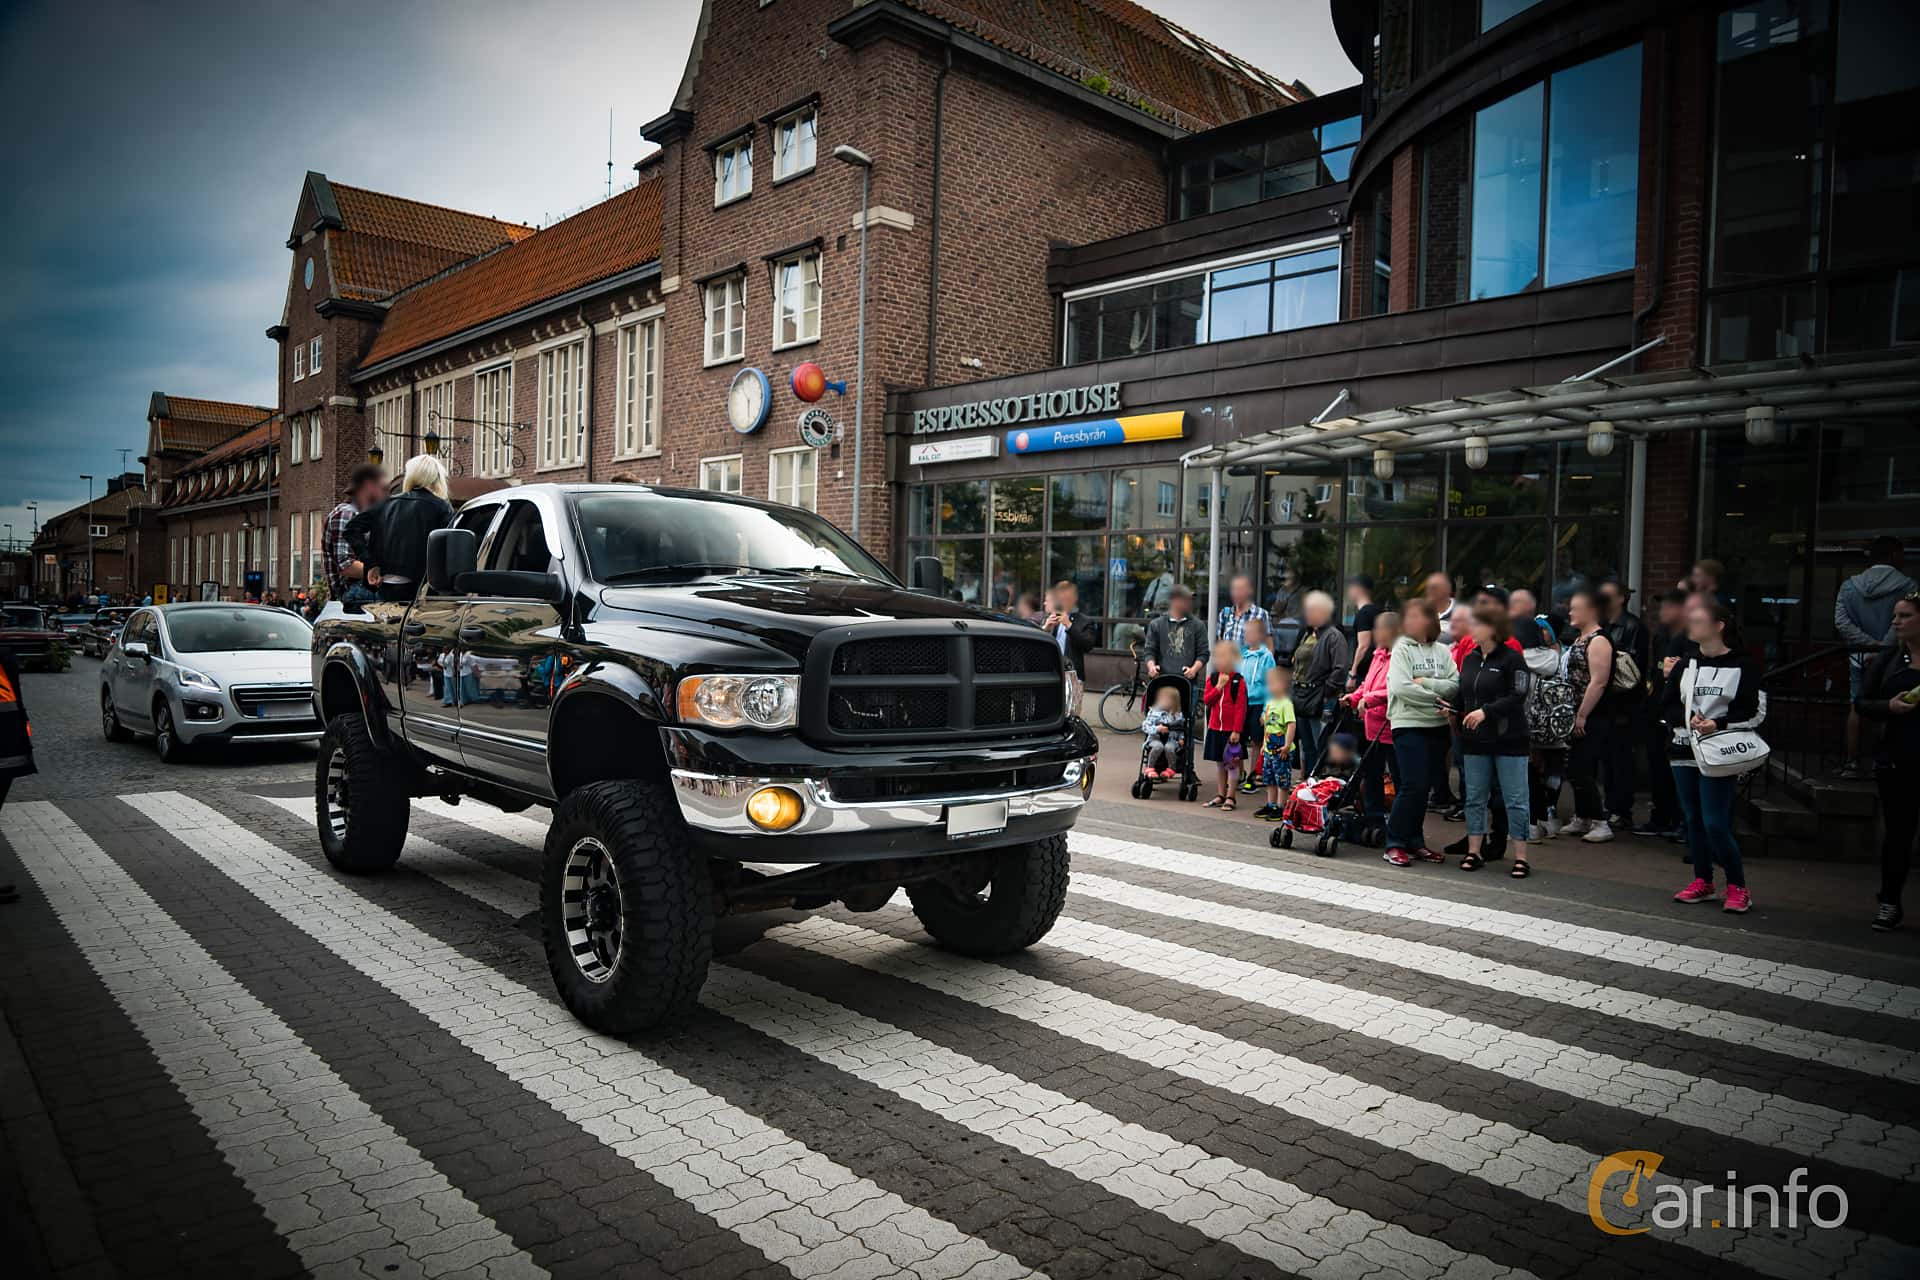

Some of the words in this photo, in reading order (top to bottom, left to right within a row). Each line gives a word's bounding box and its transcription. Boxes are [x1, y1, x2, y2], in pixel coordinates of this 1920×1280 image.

[913, 397, 1022, 434] ESPRESSO
[1020, 382, 1120, 422] HOUSE
[1054, 428, 1106, 445] Pressbyrån
